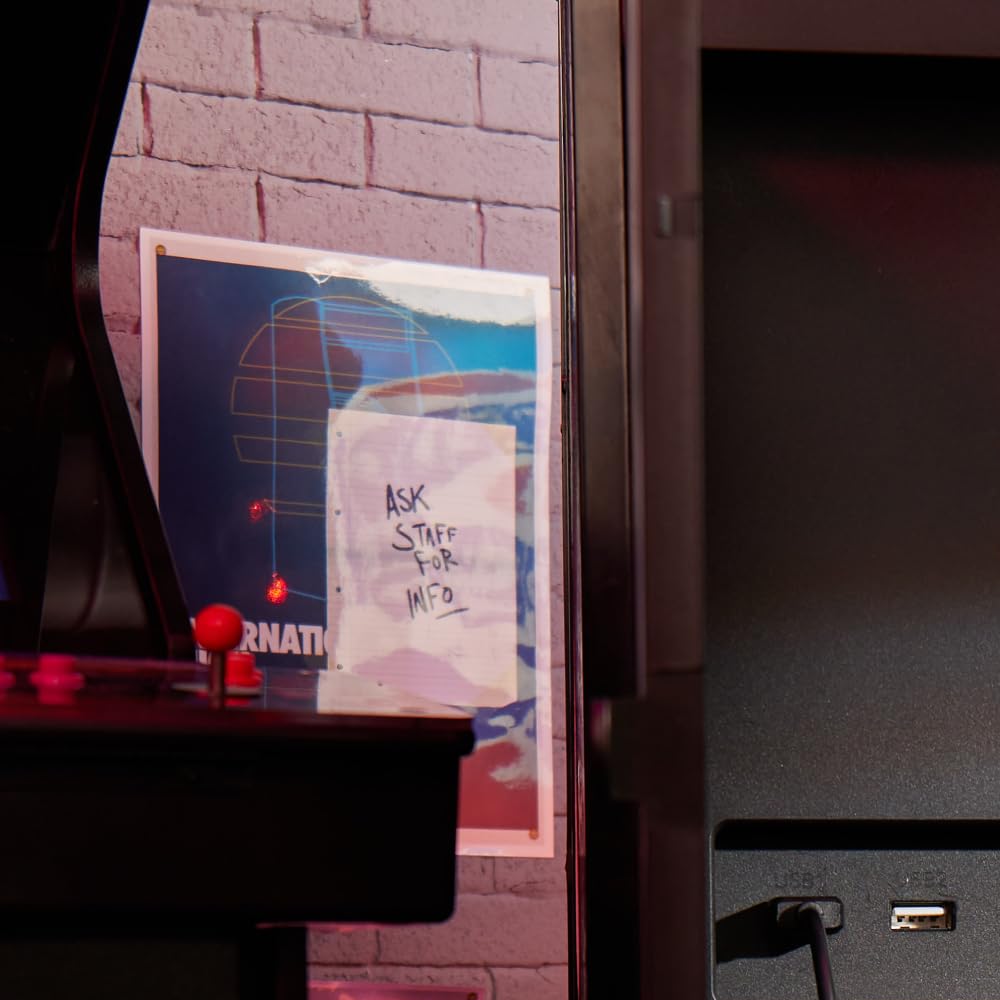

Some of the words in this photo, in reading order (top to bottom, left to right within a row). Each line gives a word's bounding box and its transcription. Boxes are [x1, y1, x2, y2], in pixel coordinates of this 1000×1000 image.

[386, 484, 430, 520] ASK
[392, 523, 457, 551] STAFF
[414, 549, 459, 576] FOR
[407, 582, 454, 619] INFO
[894, 870, 947, 888] USB2
